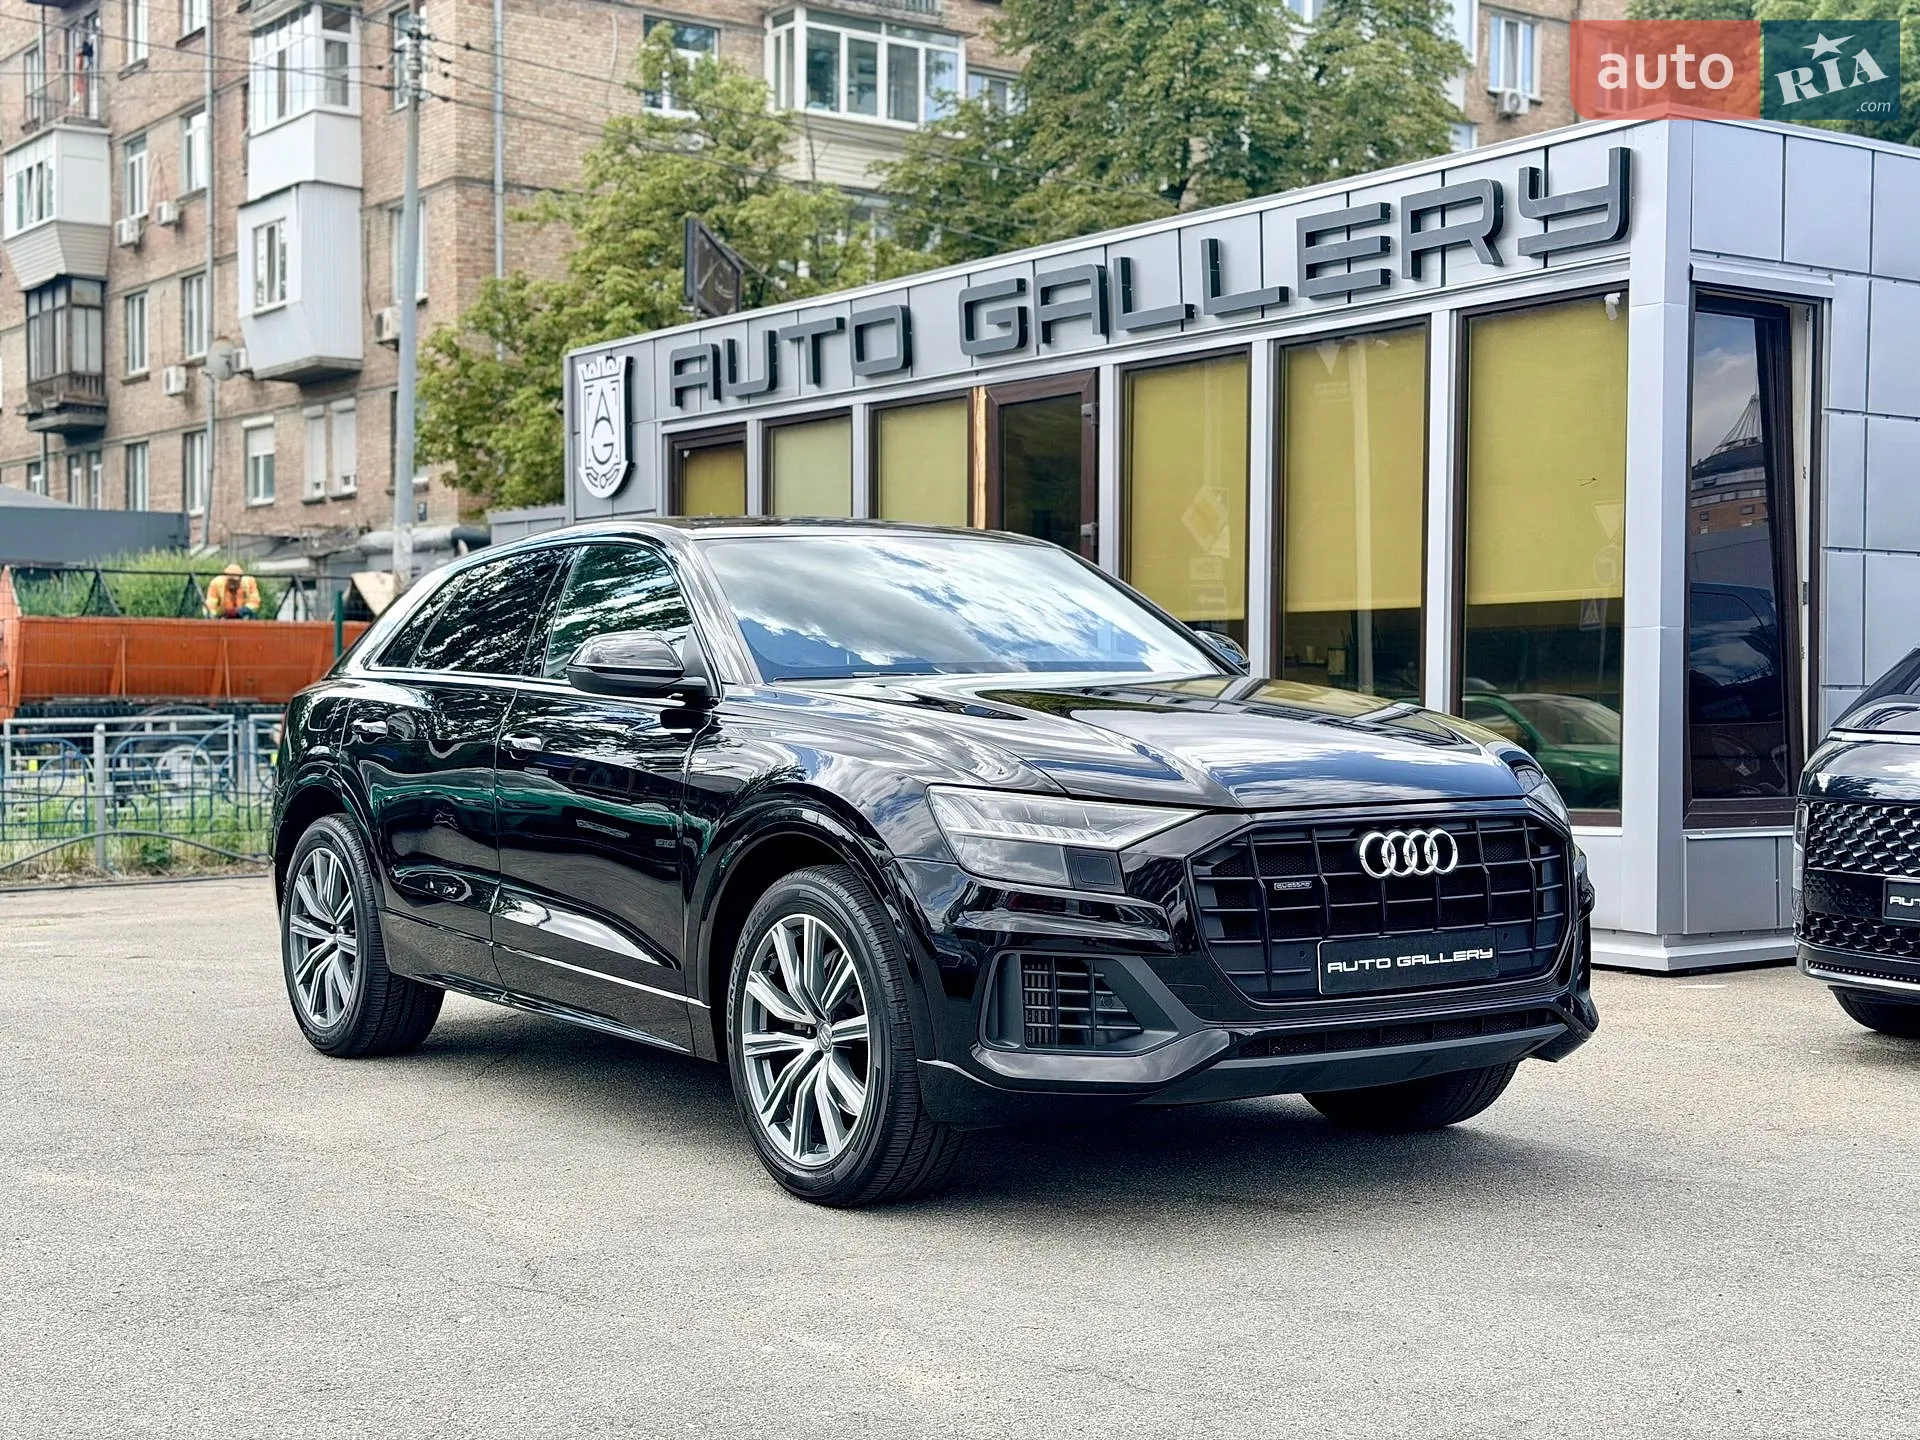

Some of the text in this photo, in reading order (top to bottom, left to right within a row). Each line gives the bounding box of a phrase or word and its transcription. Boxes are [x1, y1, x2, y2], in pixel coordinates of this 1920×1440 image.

[670, 146, 1632, 409] AUTO GALLERY
[1327, 947, 1493, 973] AUTO GALLERY
